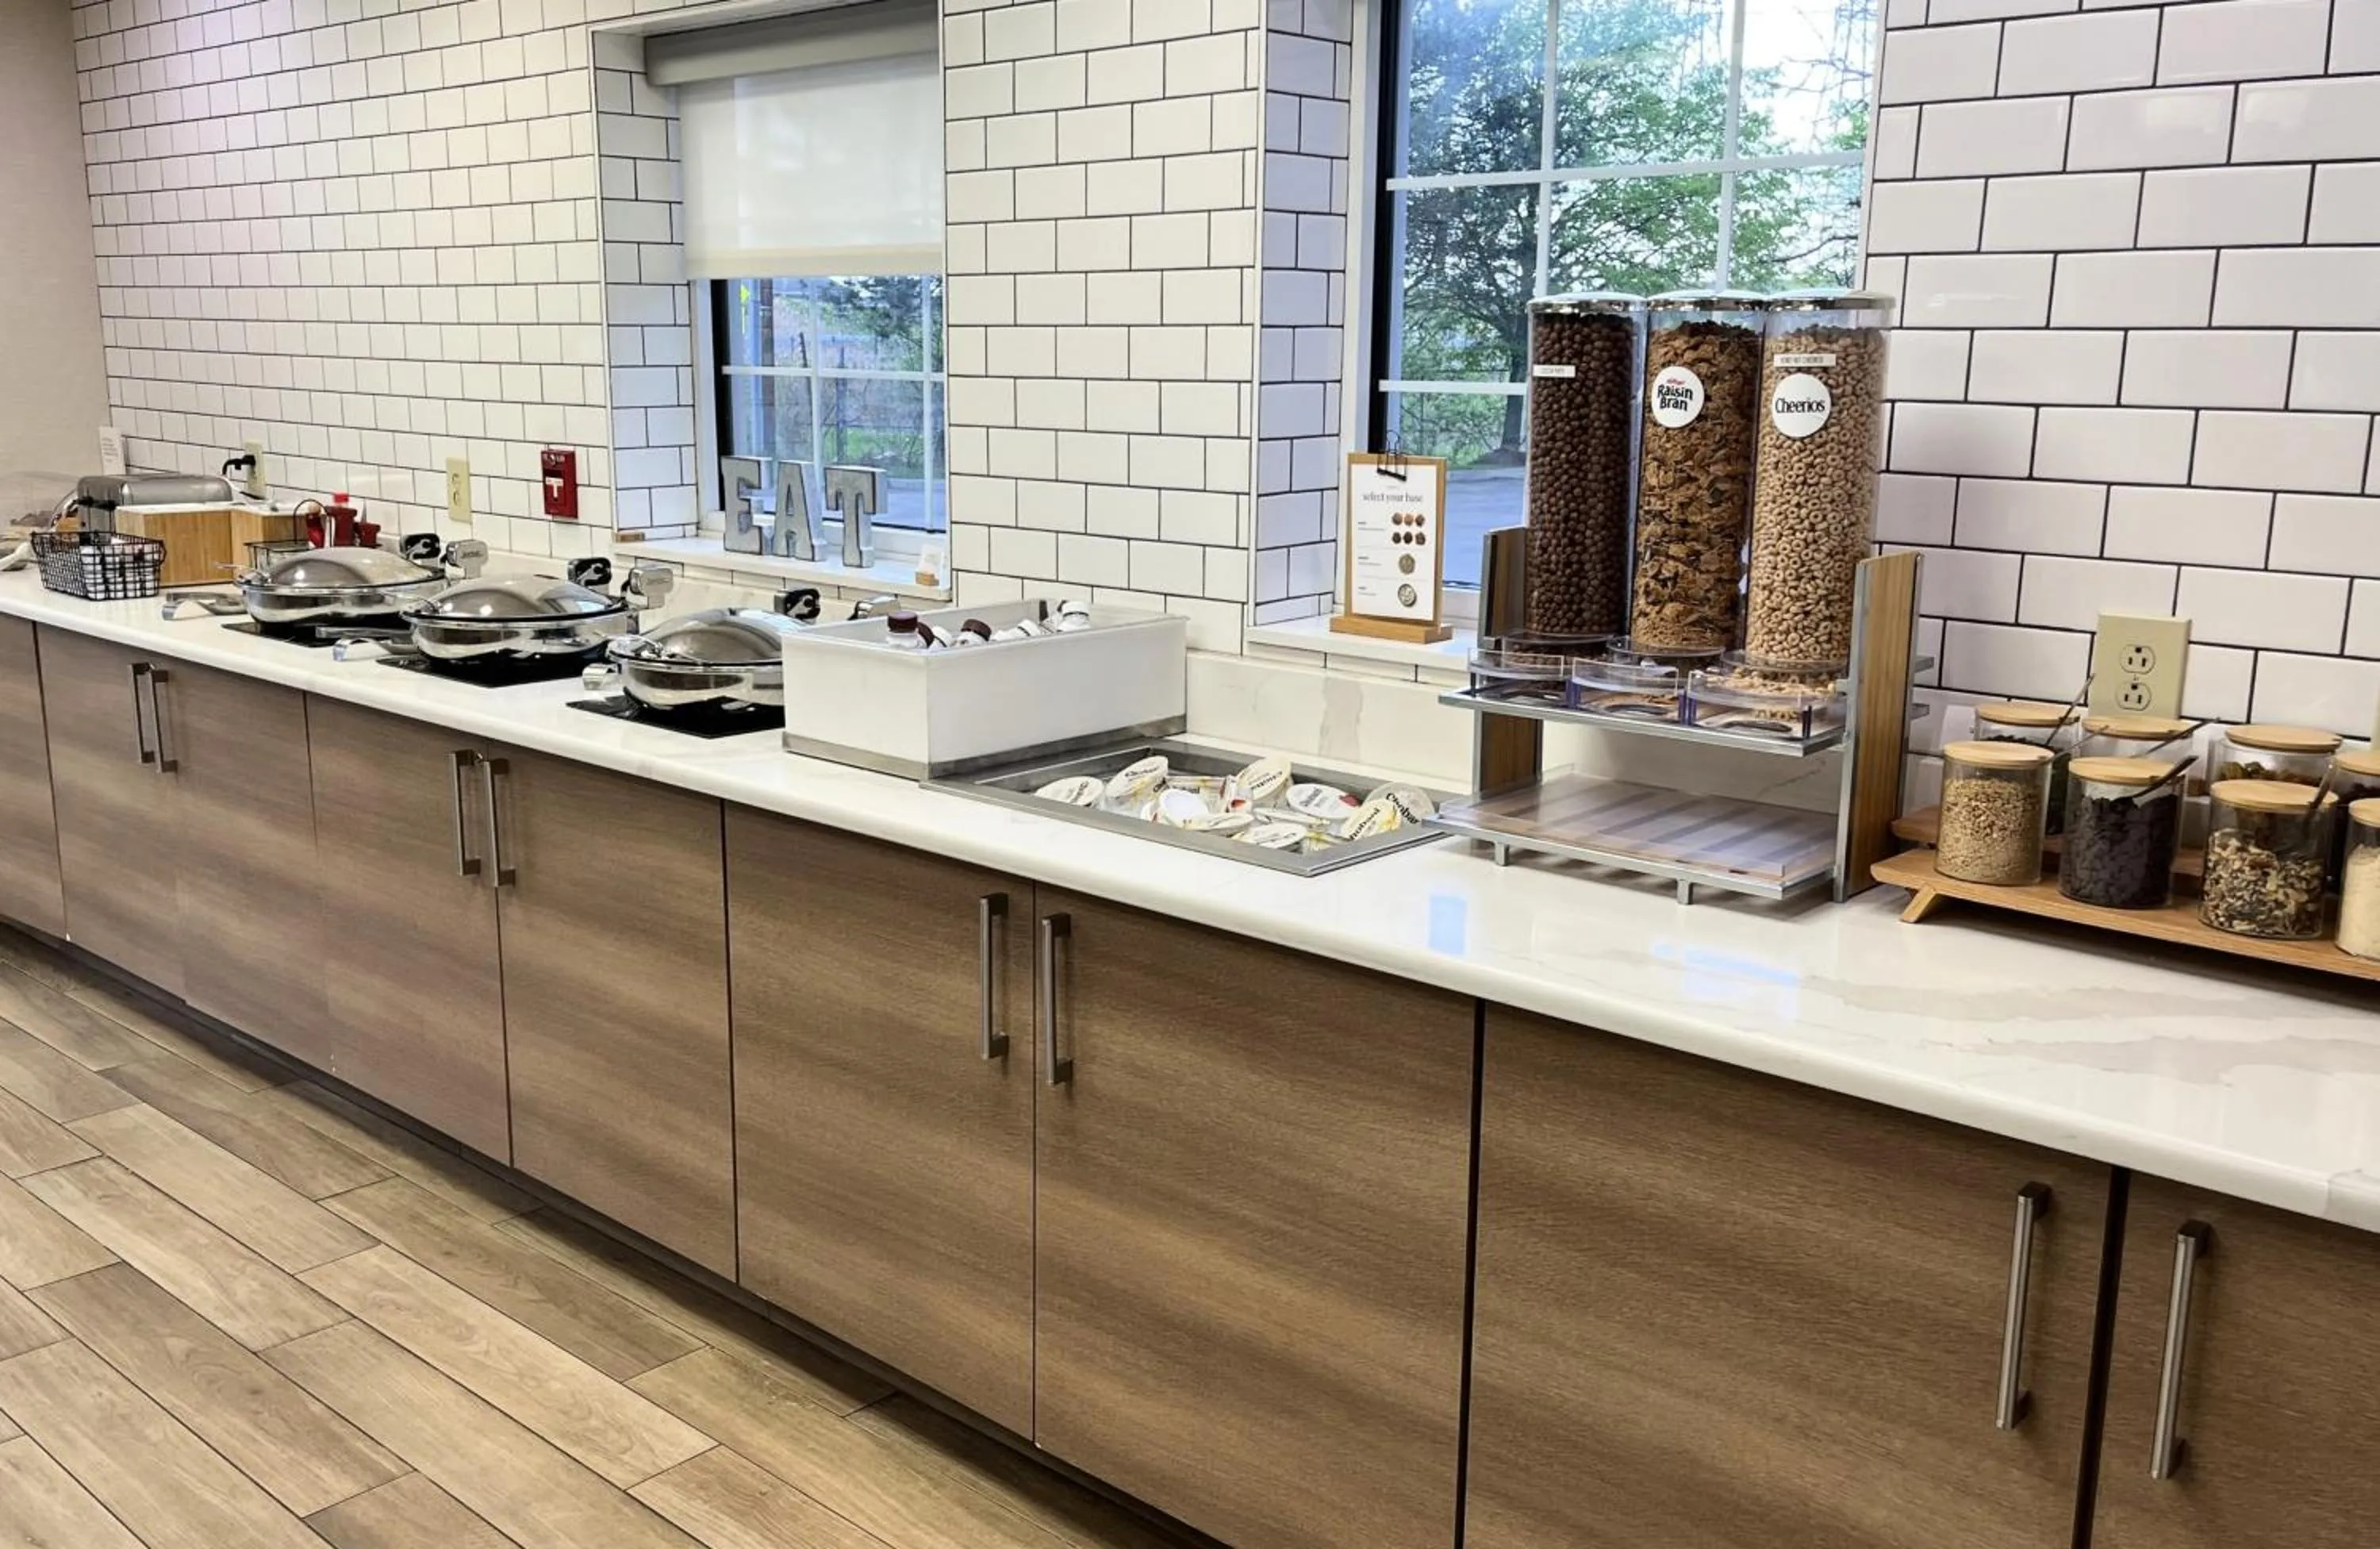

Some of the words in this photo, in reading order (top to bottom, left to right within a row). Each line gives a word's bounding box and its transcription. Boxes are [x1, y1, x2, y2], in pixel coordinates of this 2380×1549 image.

[1657, 384, 1693, 401] Raisin
[1660, 398, 1687, 412] Bran
[1775, 397, 1825, 413] Cheerios
[720, 455, 878, 568] EAT
